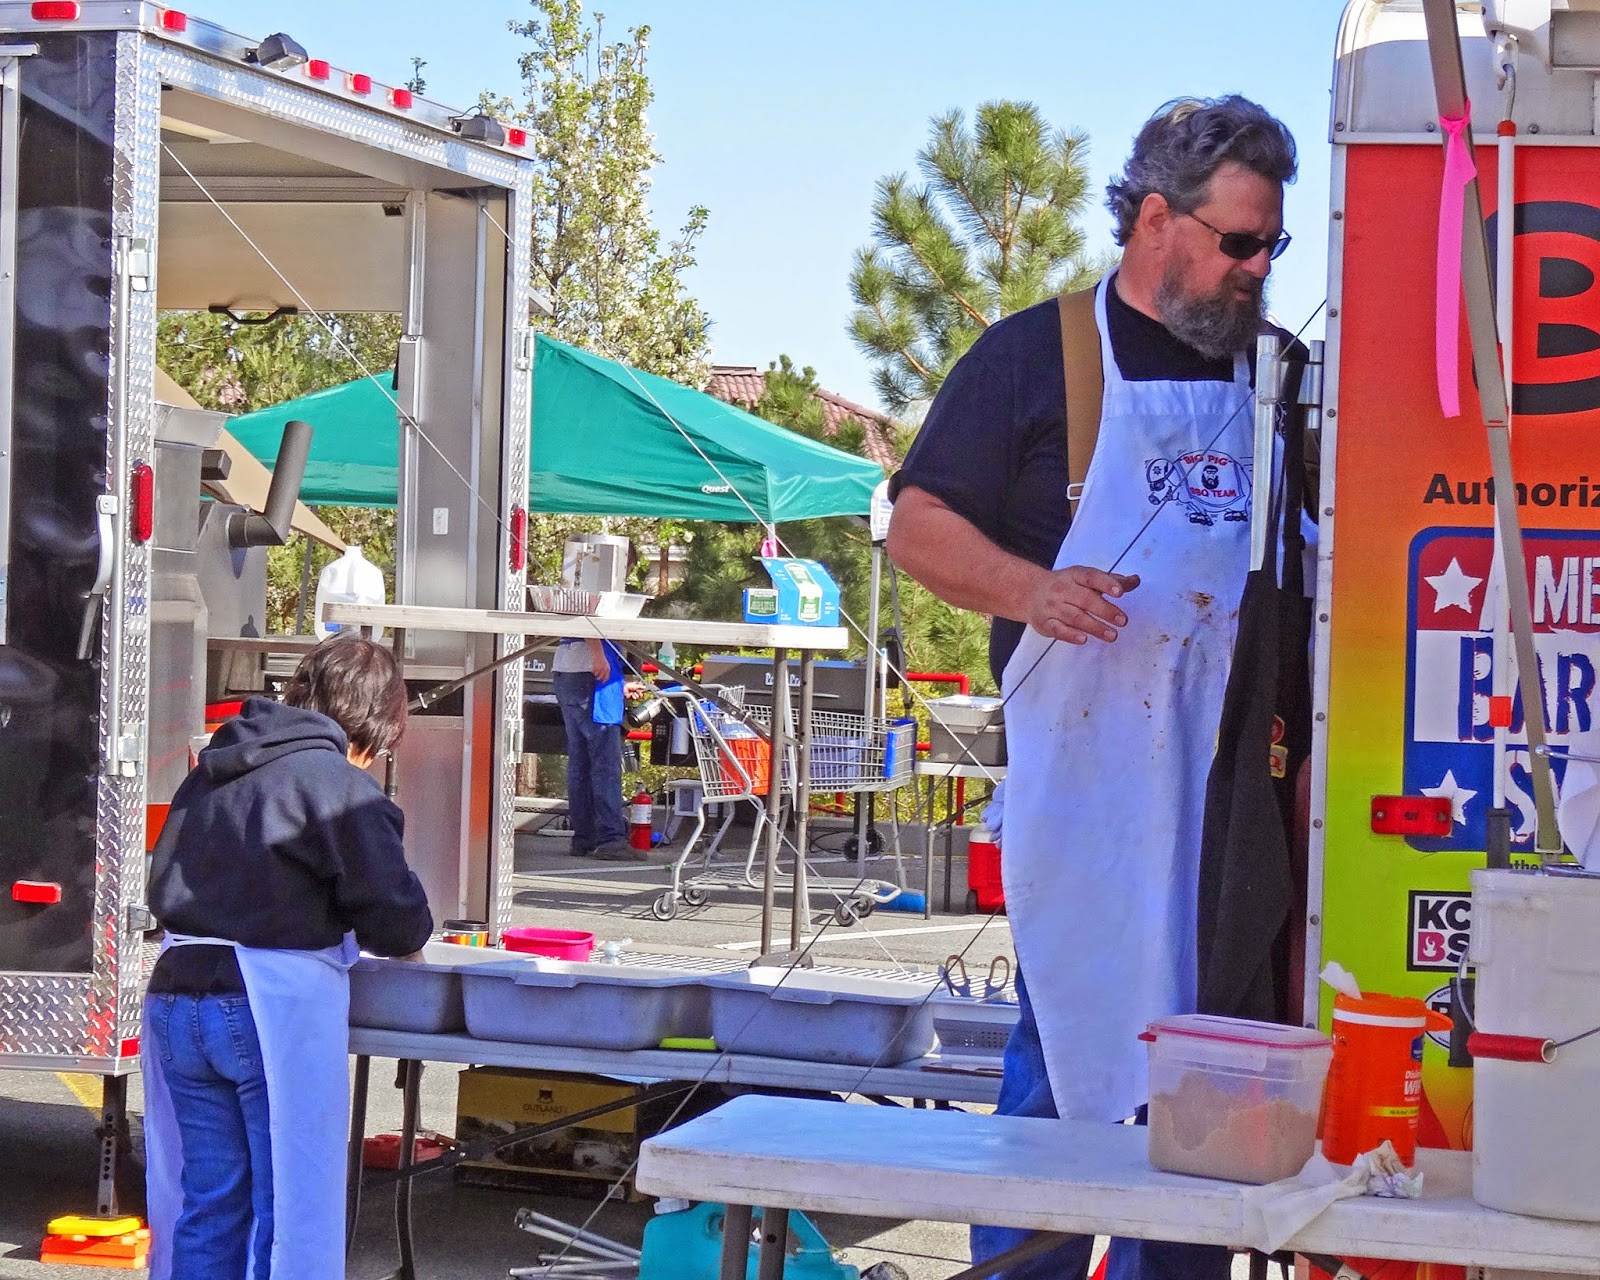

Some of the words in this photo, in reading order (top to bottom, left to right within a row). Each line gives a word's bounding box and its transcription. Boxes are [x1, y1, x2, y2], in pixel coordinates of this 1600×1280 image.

[1183, 455, 1204, 464] BIG
[1207, 455, 1228, 466] PIG
[701, 484, 730, 494] Quest
[1190, 487, 1209, 498] BBQ
[1212, 489, 1236, 498] TEAM
[1418, 899, 1471, 931] KC
[1417, 931, 1470, 965] BS
